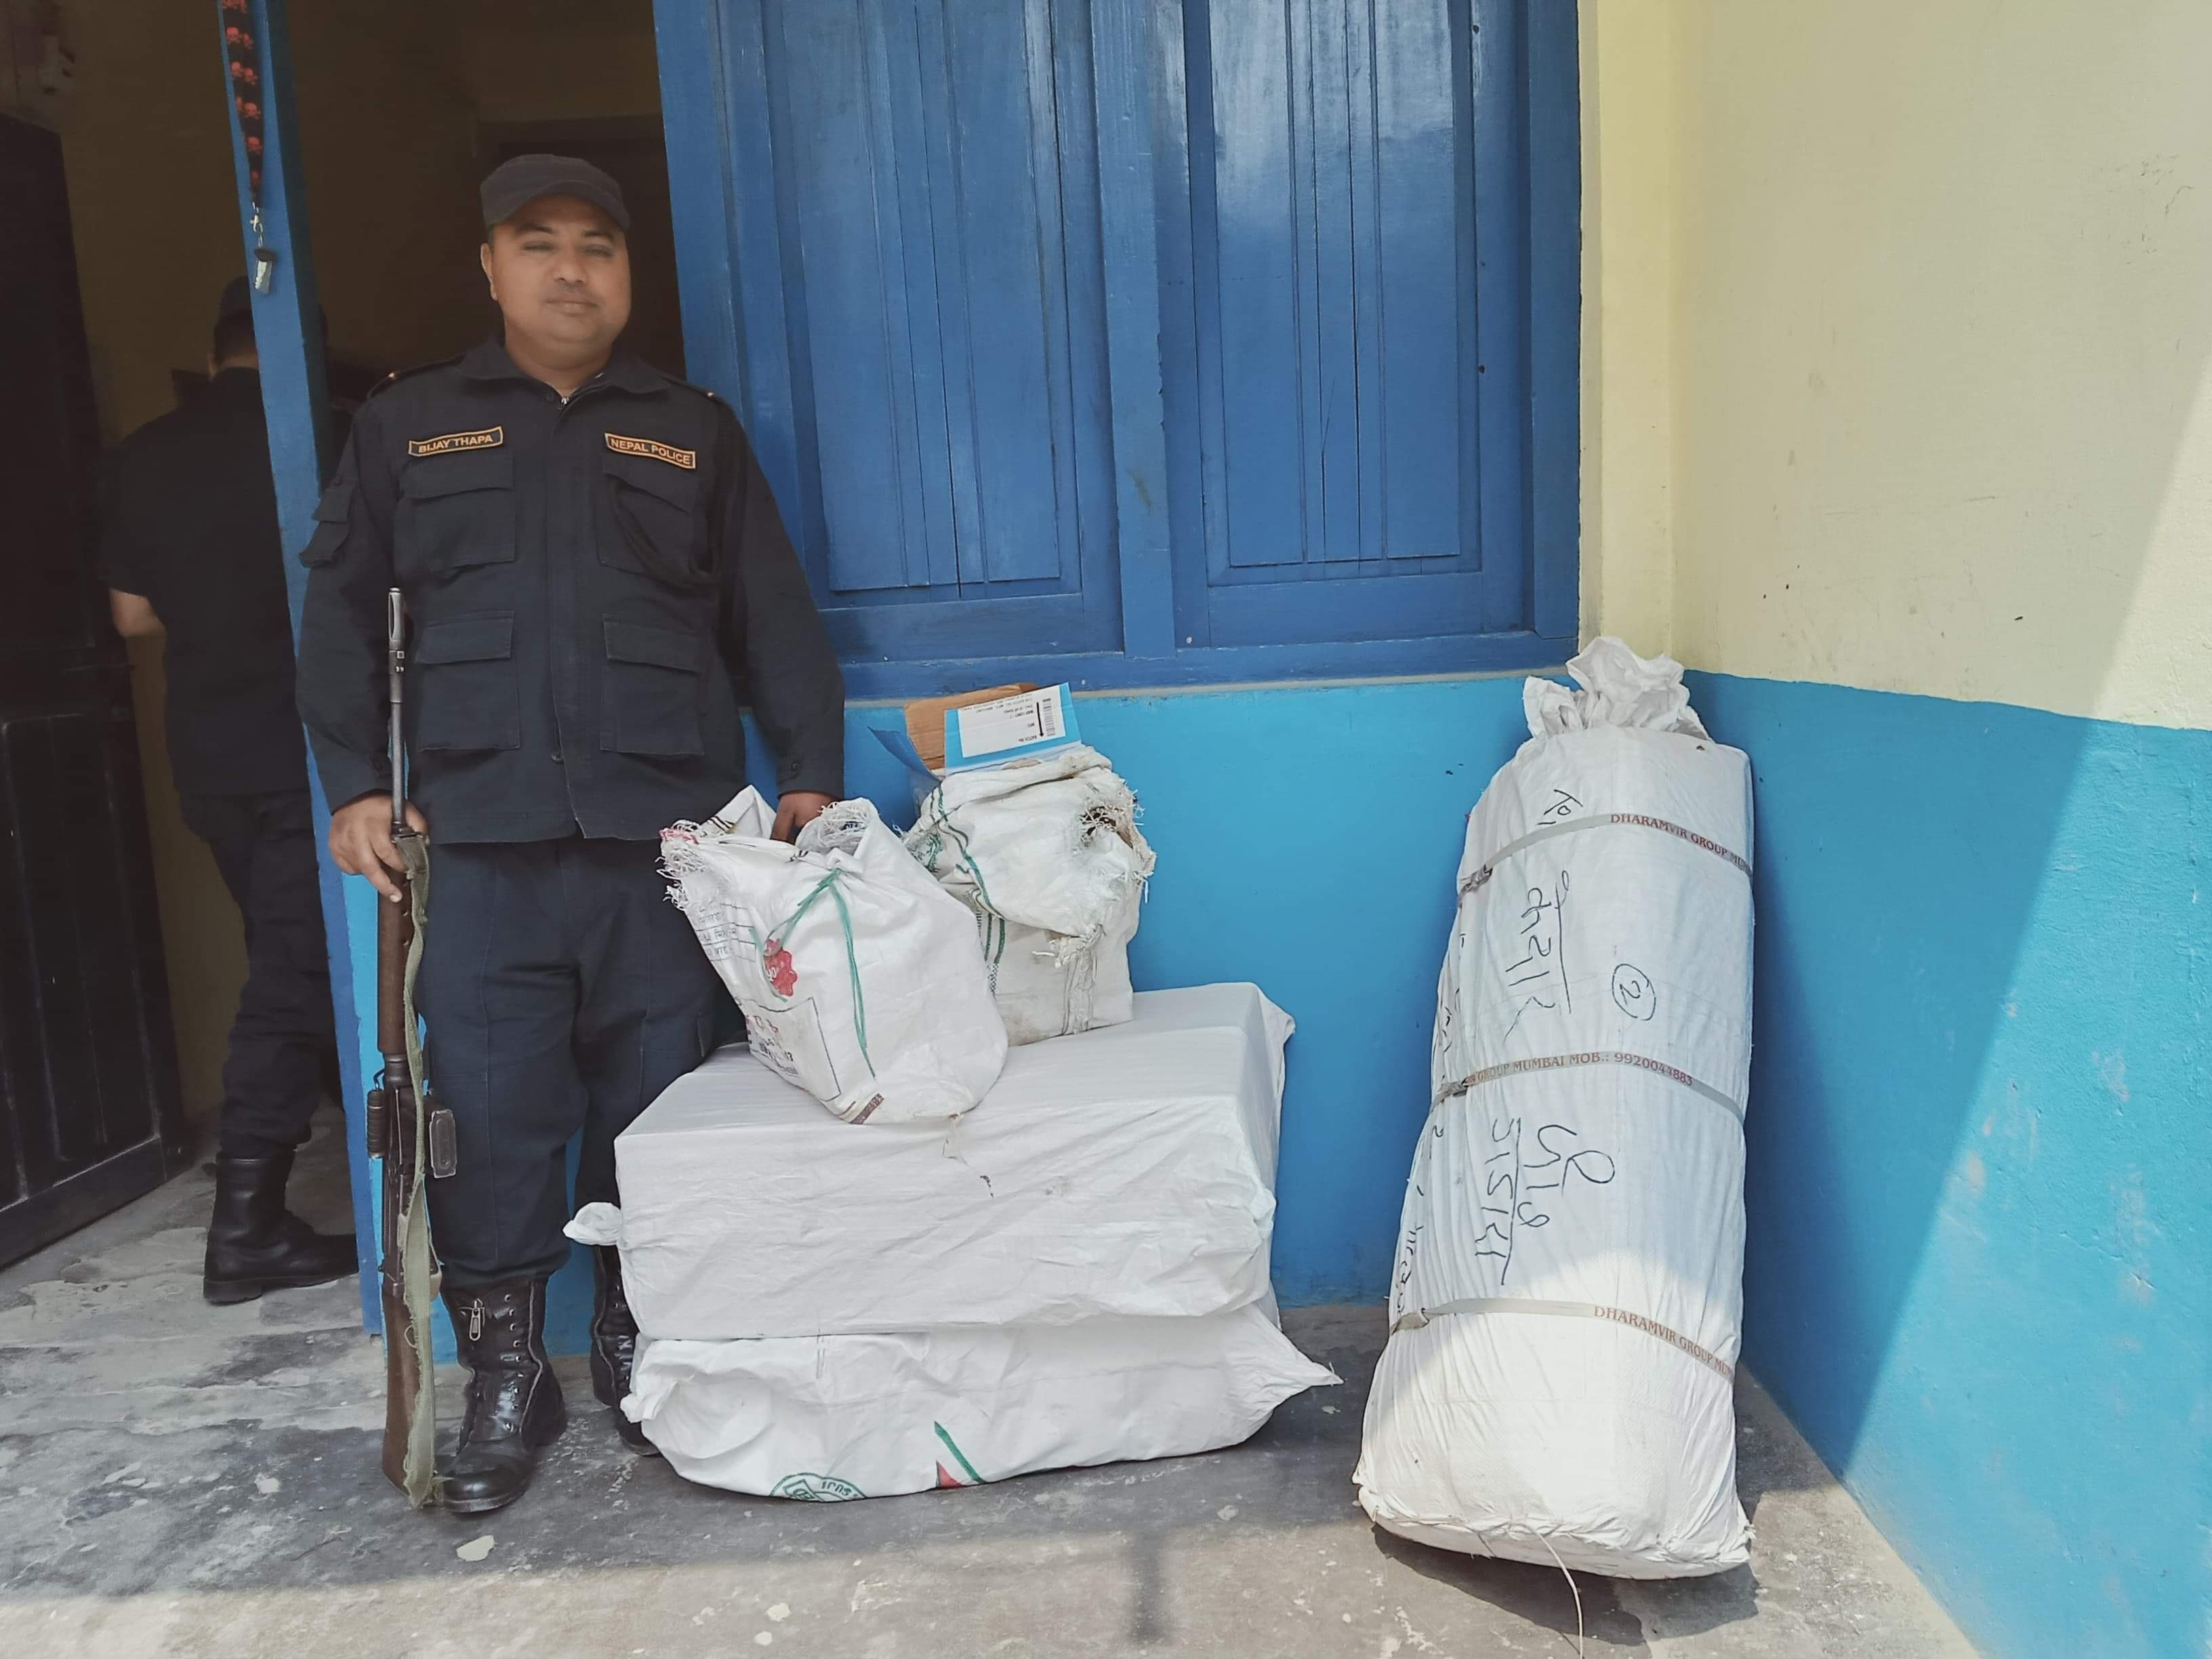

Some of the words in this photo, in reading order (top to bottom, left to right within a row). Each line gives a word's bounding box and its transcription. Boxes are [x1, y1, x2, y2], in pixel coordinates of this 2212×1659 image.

[418, 438, 450, 454] BIJAY
[454, 434, 493, 448] THAPA
[611, 437, 649, 453] NEPAL
[650, 444, 691, 465] POLICE
[1610, 813, 1687, 840] DHARAMVIR
[1690, 834, 1728, 857] GROUP
[1477, 1064, 1510, 1082] GROUP
[1513, 1054, 1565, 1074] MUMBAI
[1614, 1052, 1693, 1086] 9920044883
[1593, 1305, 1677, 1343] DHARAMVIR
[1680, 1336, 1715, 1364] GROUP
